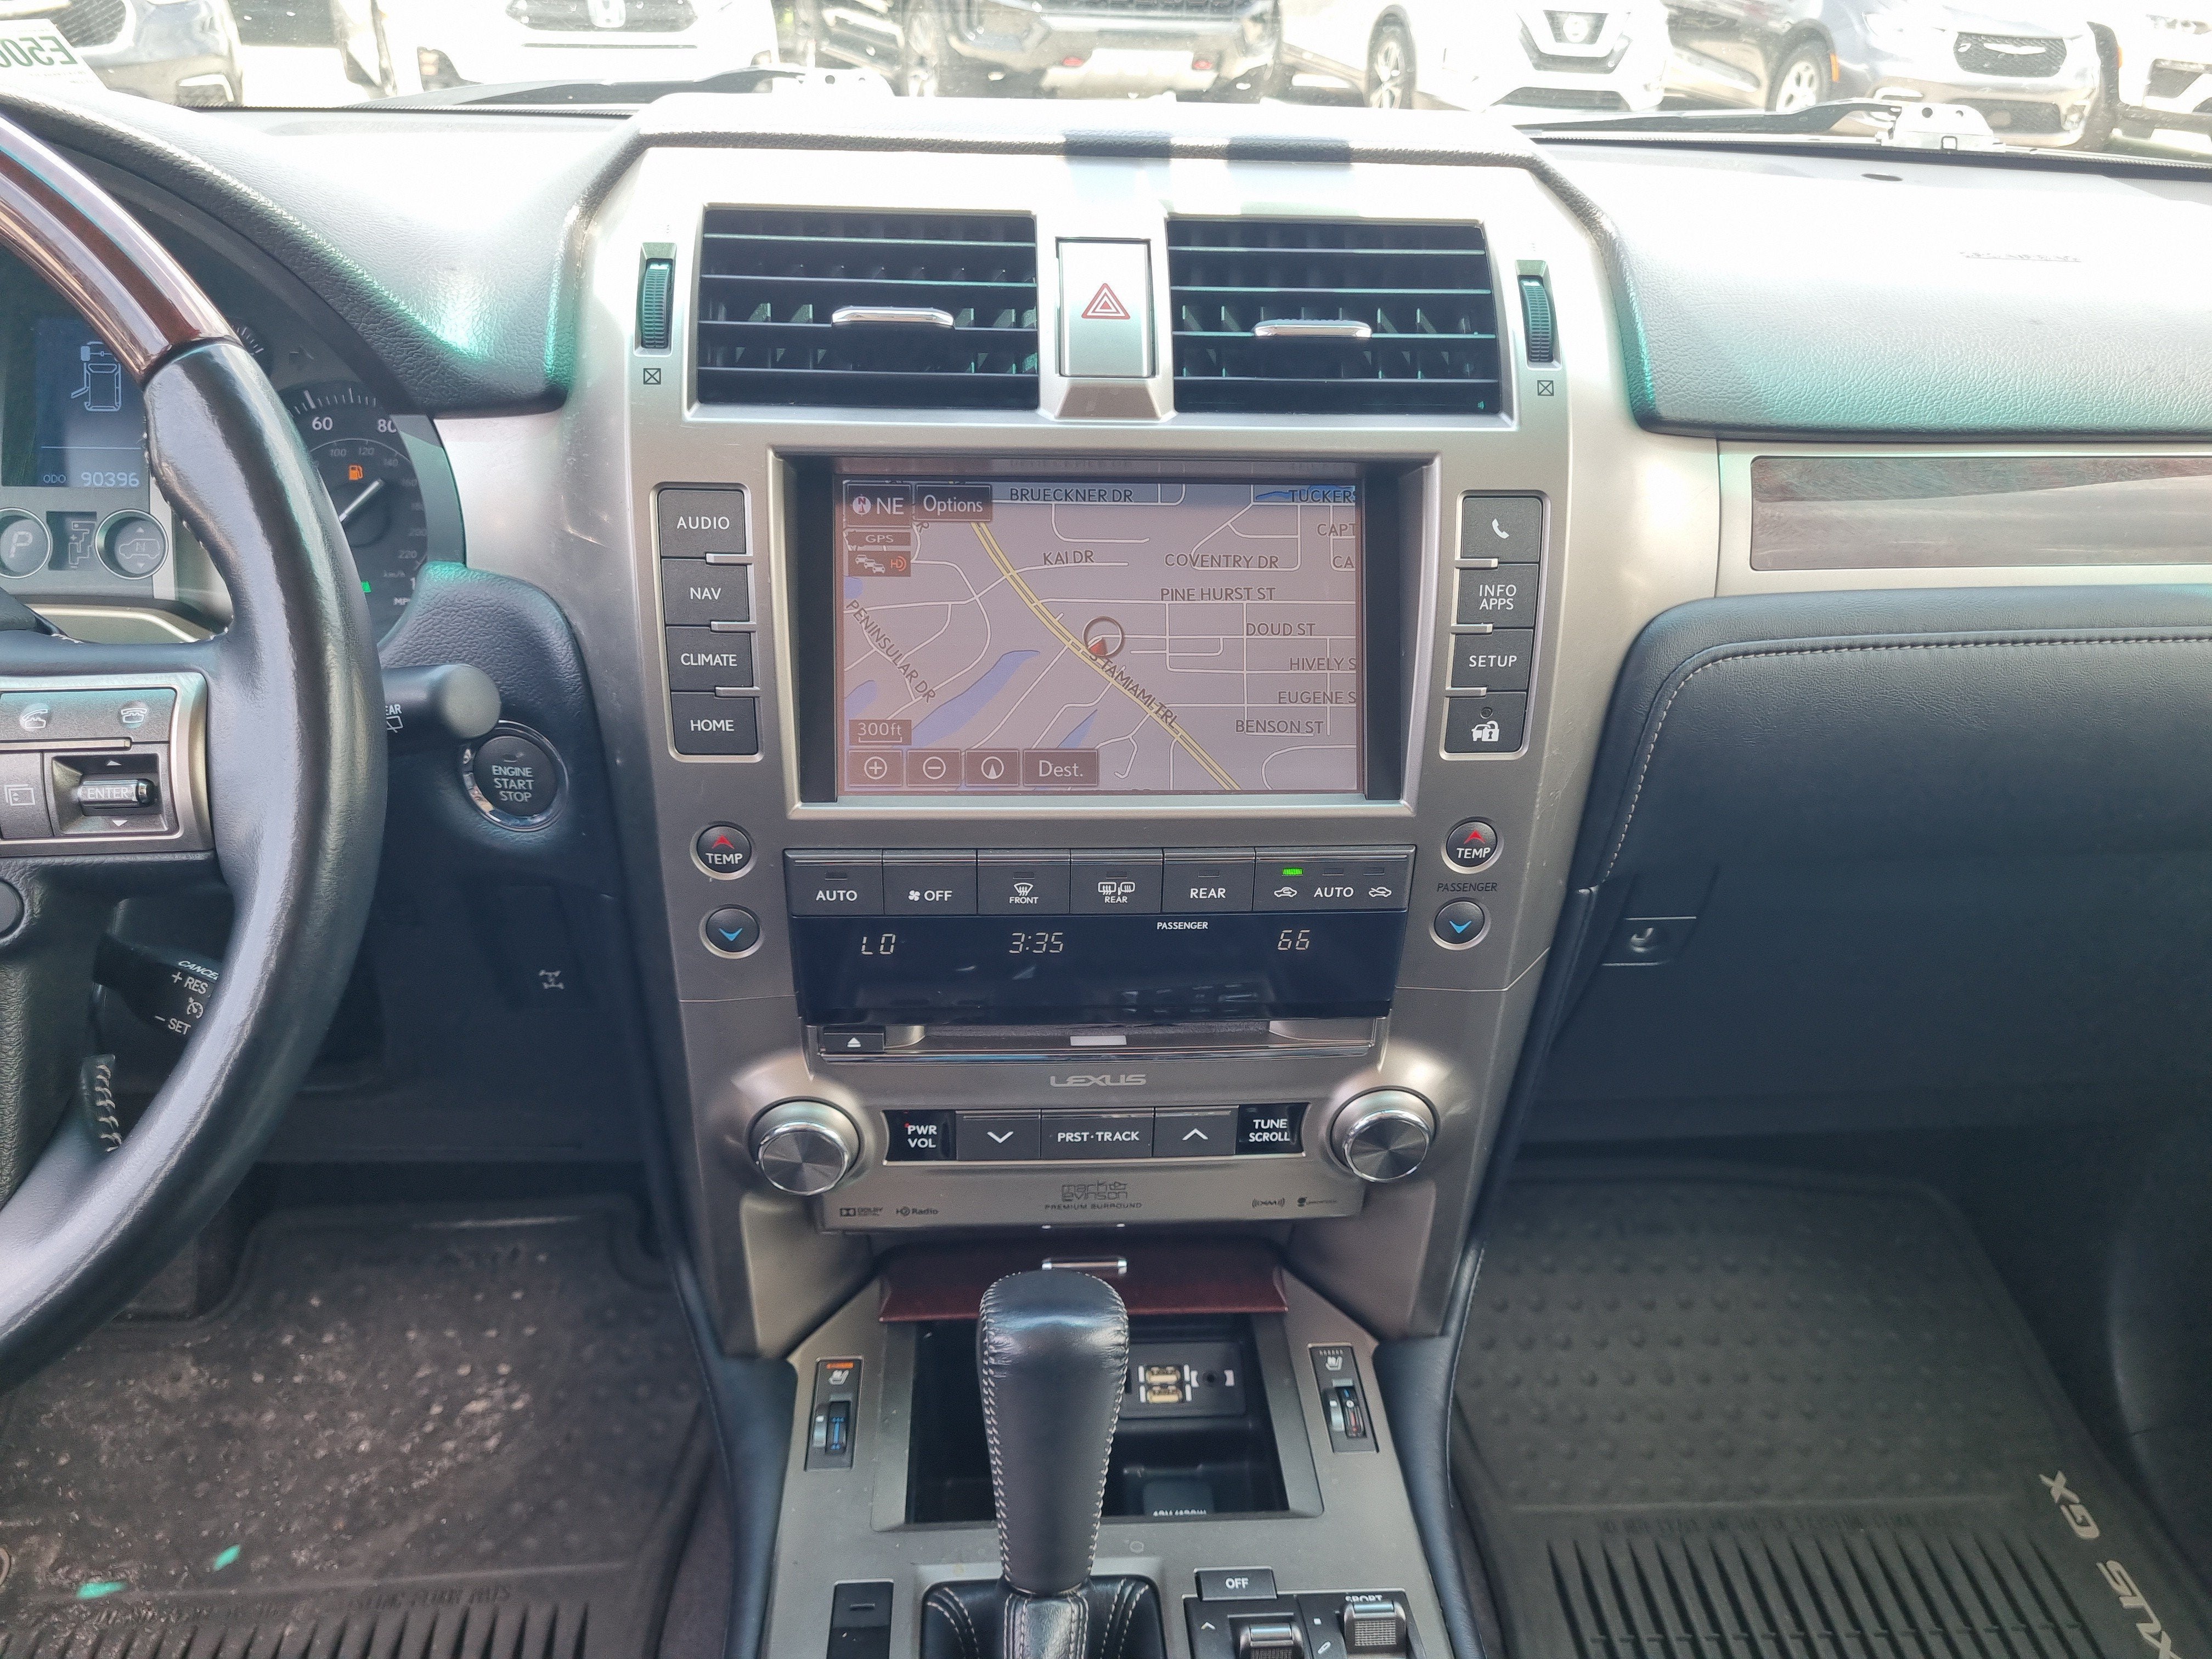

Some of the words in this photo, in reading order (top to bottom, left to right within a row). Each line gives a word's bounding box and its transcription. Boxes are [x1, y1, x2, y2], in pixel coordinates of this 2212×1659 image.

[312, 416, 333, 431] 60
[43, 474, 66, 484] ODO
[81, 471, 140, 487] 90396
[1009, 488, 1108, 503] BRUECKNER
[1112, 489, 1134, 503] DR
[876, 497, 904, 515] NE
[923, 495, 984, 514] Options
[676, 516, 730, 530] AUDIO
[865, 534, 894, 543] GPS
[1042, 552, 1069, 566] KAI
[1073, 550, 1095, 564] DR
[1164, 554, 1254, 568] COVENTRY
[1258, 555, 1279, 569] DR
[690, 587, 721, 600] NAV
[1160, 587, 1196, 601] PINE
[1200, 587, 1253, 601] HURST
[1257, 587, 1276, 601] ST
[1479, 584, 1517, 597] INFO
[393, 596, 411, 606] MP
[1479, 598, 1514, 610] APPS
[1246, 623, 1293, 636] DOUD
[1297, 623, 1316, 636] ST
[845, 600, 919, 685] PENINSULAR
[914, 681, 936, 703] DR
[681, 653, 738, 667] CLIMATE
[1290, 657, 1344, 671] HIVELY
[1469, 655, 1517, 668] SETUP
[1101, 658, 1156, 709] TAMIAMI
[1153, 702, 1178, 729] TRL
[1278, 691, 1344, 704] EUGENE
[690, 719, 735, 732] HOME
[857, 721, 902, 737] 300ft
[1235, 719, 1301, 733] BENSON
[1305, 720, 1324, 734] ST
[492, 765, 533, 777] ENGINE
[1039, 760, 1084, 778] Dest.
[494, 778, 535, 790] START
[87, 787, 129, 799] ENTER
[500, 791, 532, 803] STOP
[706, 852, 743, 866] TEMP
[1456, 847, 1491, 859] TEMP
[1190, 887, 1226, 899] REAR
[1314, 887, 1354, 899] AUTO
[1436, 882, 1498, 893] PASSENGER
[816, 889, 857, 901] AUTO
[924, 889, 952, 901] OFF
[1009, 896, 1039, 905] FRONT
[1104, 895, 1128, 904] REAR
[1156, 921, 1209, 930] PASSENGER
[1008, 932, 1064, 954] 3:35
[1277, 929, 1310, 951] 66
[178, 961, 219, 980] CANCE
[184, 976, 208, 994] RES
[168, 1018, 191, 1035] SET
[1049, 1074, 1147, 1088] LEXUS
[907, 1124, 938, 1136] PWR
[1252, 1118, 1288, 1129] TUNE
[907, 1138, 936, 1148] VOL
[1248, 1131, 1291, 1142] SCROLL
[911, 1207, 939, 1215] Radio
[1225, 1577, 1249, 1589] OFF
[2096, 1560, 2182, 1659] XUS
